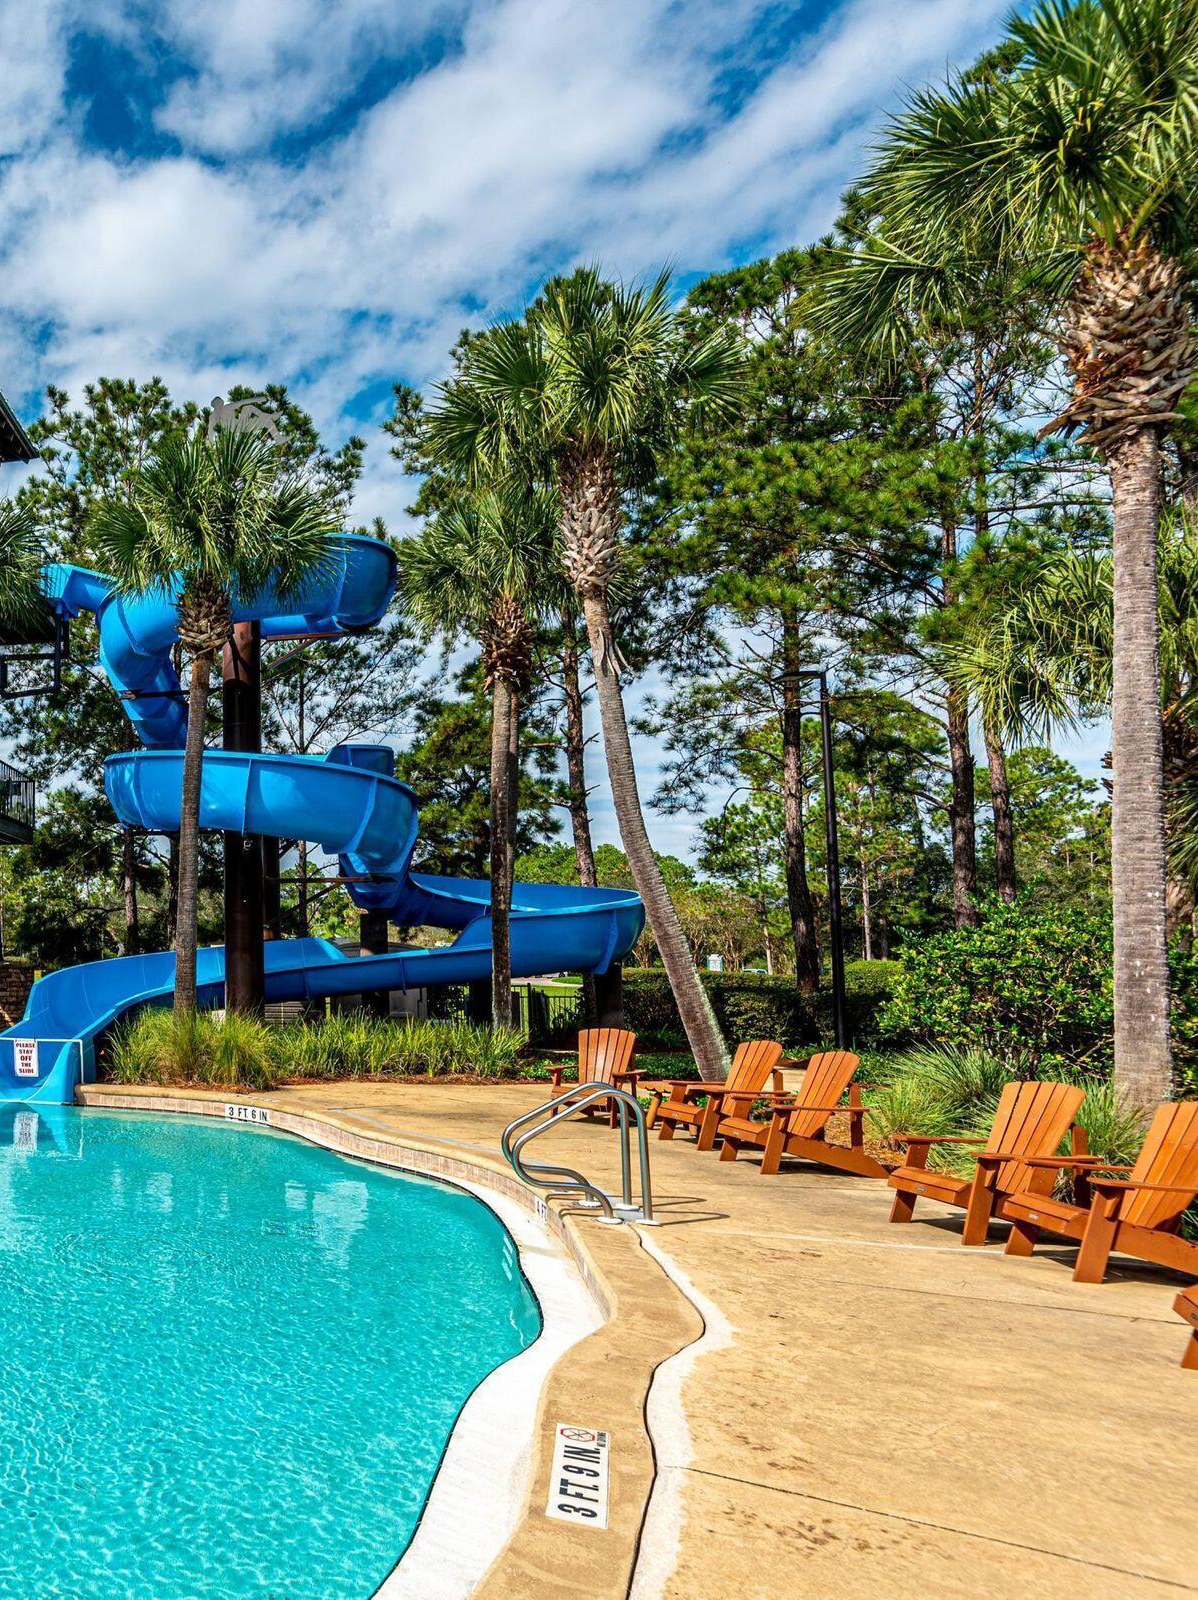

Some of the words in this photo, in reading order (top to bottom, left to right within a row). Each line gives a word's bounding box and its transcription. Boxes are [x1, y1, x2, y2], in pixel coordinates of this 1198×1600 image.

[229, 1106, 234, 1116] 3
[252, 1110, 256, 1119] 6
[563, 1445, 600, 1464] IN.
[562, 1465, 600, 1477] 9
[559, 1478, 599, 1503] FT.
[558, 1503, 598, 1518] 3
